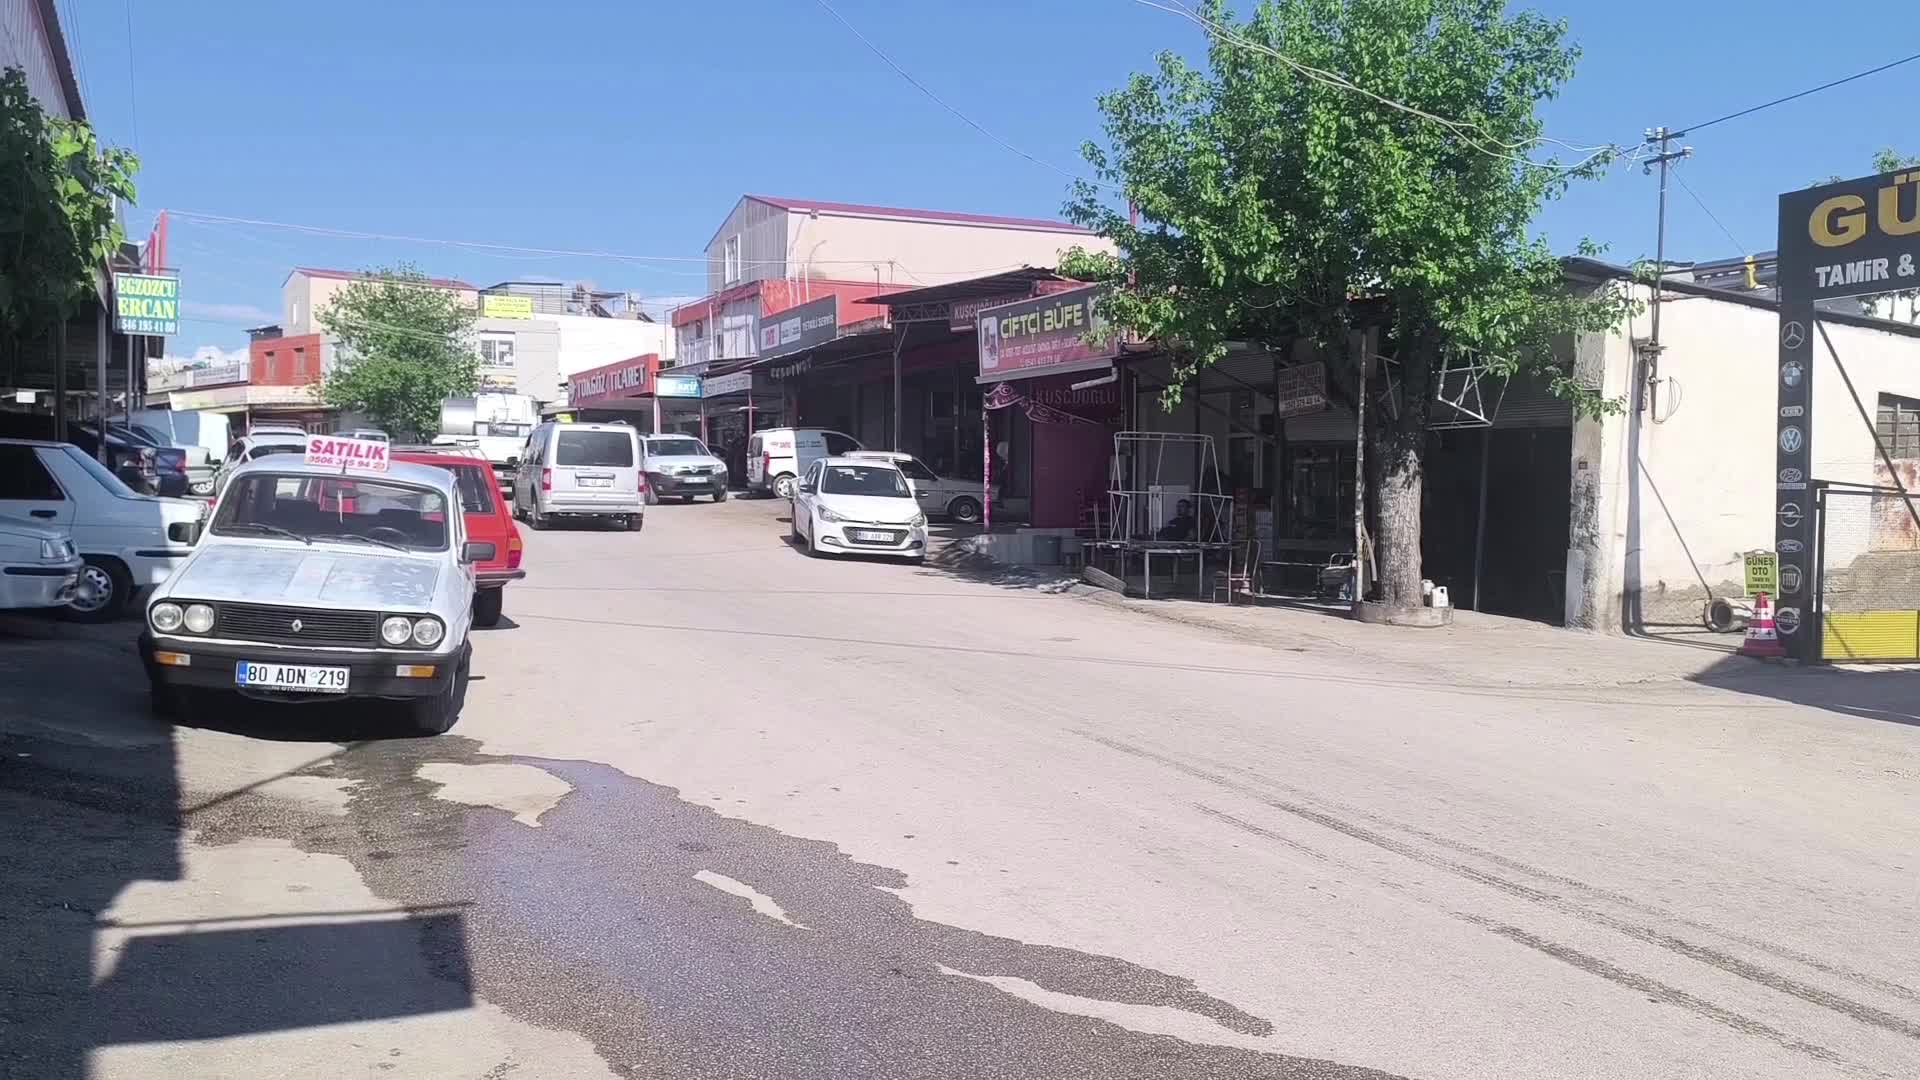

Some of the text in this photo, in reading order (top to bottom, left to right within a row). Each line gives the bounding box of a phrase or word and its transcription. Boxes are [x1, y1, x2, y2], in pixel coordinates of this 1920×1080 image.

[1897, 254, 1915, 277] &
[117, 297, 176, 320] ERCAN
[1044, 302, 1083, 332] BÜFE
[310, 440, 385, 460] SATILIK
[1746, 556, 1774, 568] GÜNEŞ
[1752, 567, 1768, 576] OTO
[248, 665, 267, 682] 80
[276, 668, 306, 685] ADN
[318, 669, 345, 686] 219
